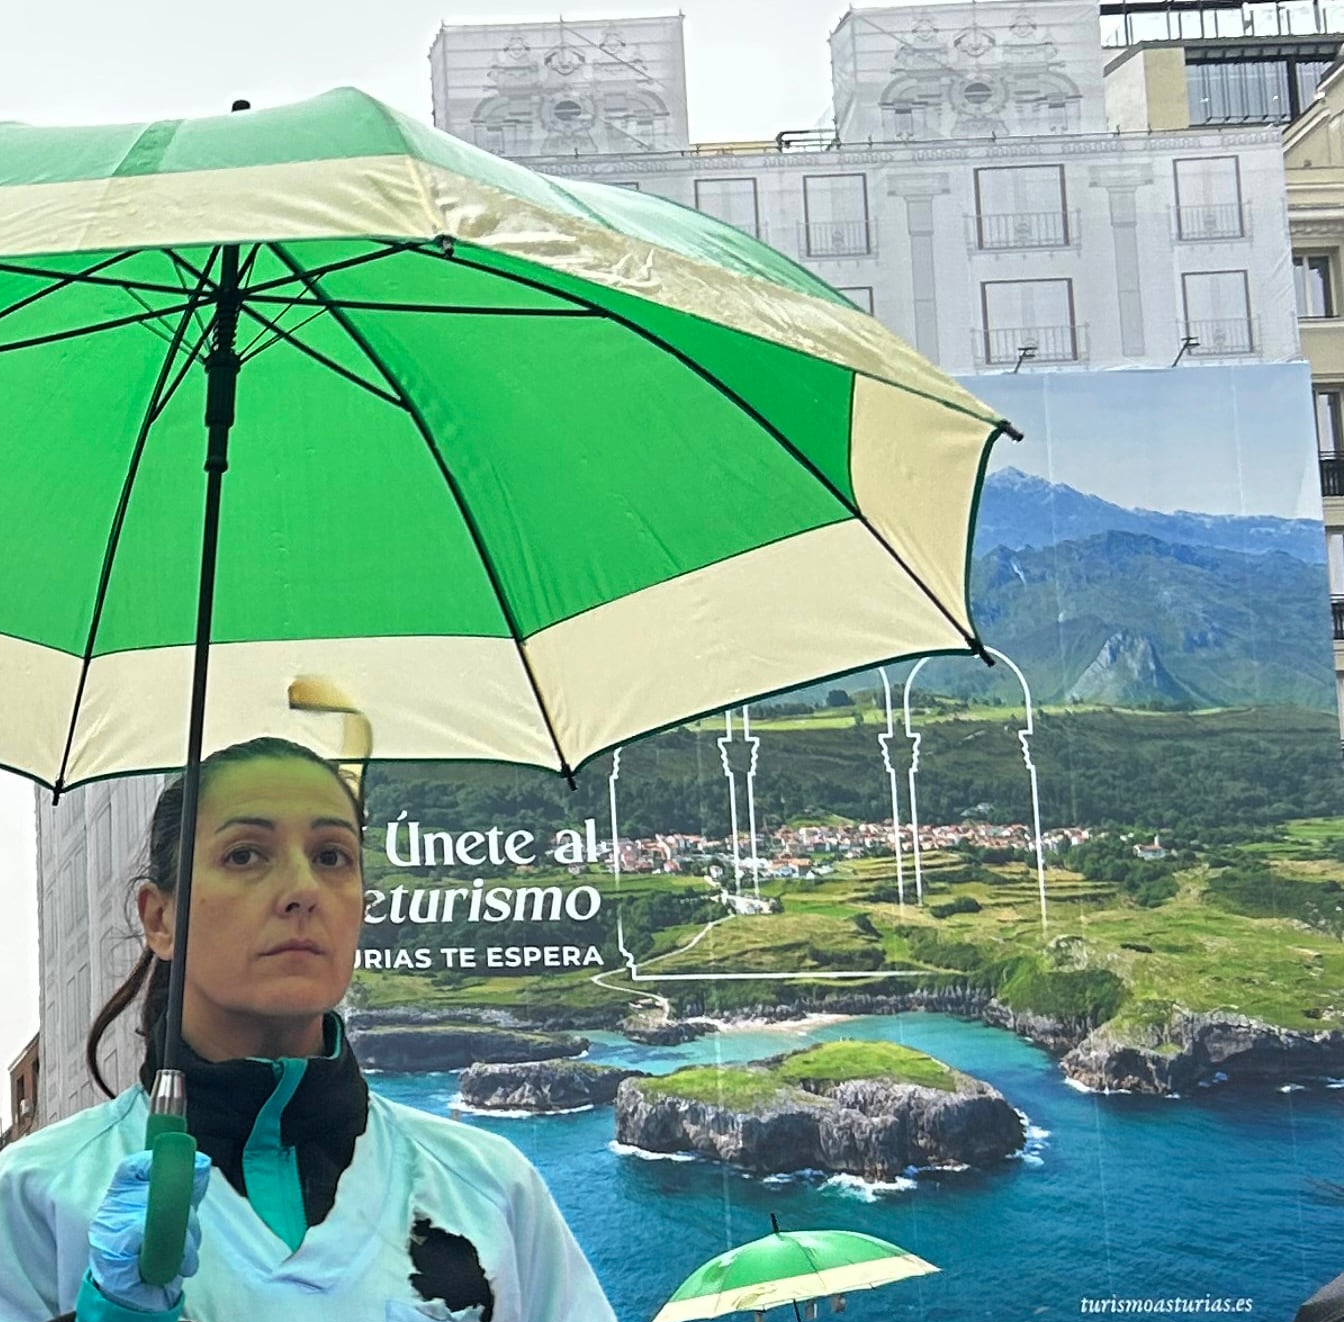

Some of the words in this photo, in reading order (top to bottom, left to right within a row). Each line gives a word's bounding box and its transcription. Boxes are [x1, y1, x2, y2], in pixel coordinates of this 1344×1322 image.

[385, 810, 537, 868] Únete
[553, 817, 599, 864] al
[362, 877, 602, 925] eturismo
[440, 947, 477, 968] TE
[487, 944, 605, 969] ESPERA
[1080, 1293, 1254, 1313] turismoasturias.es
